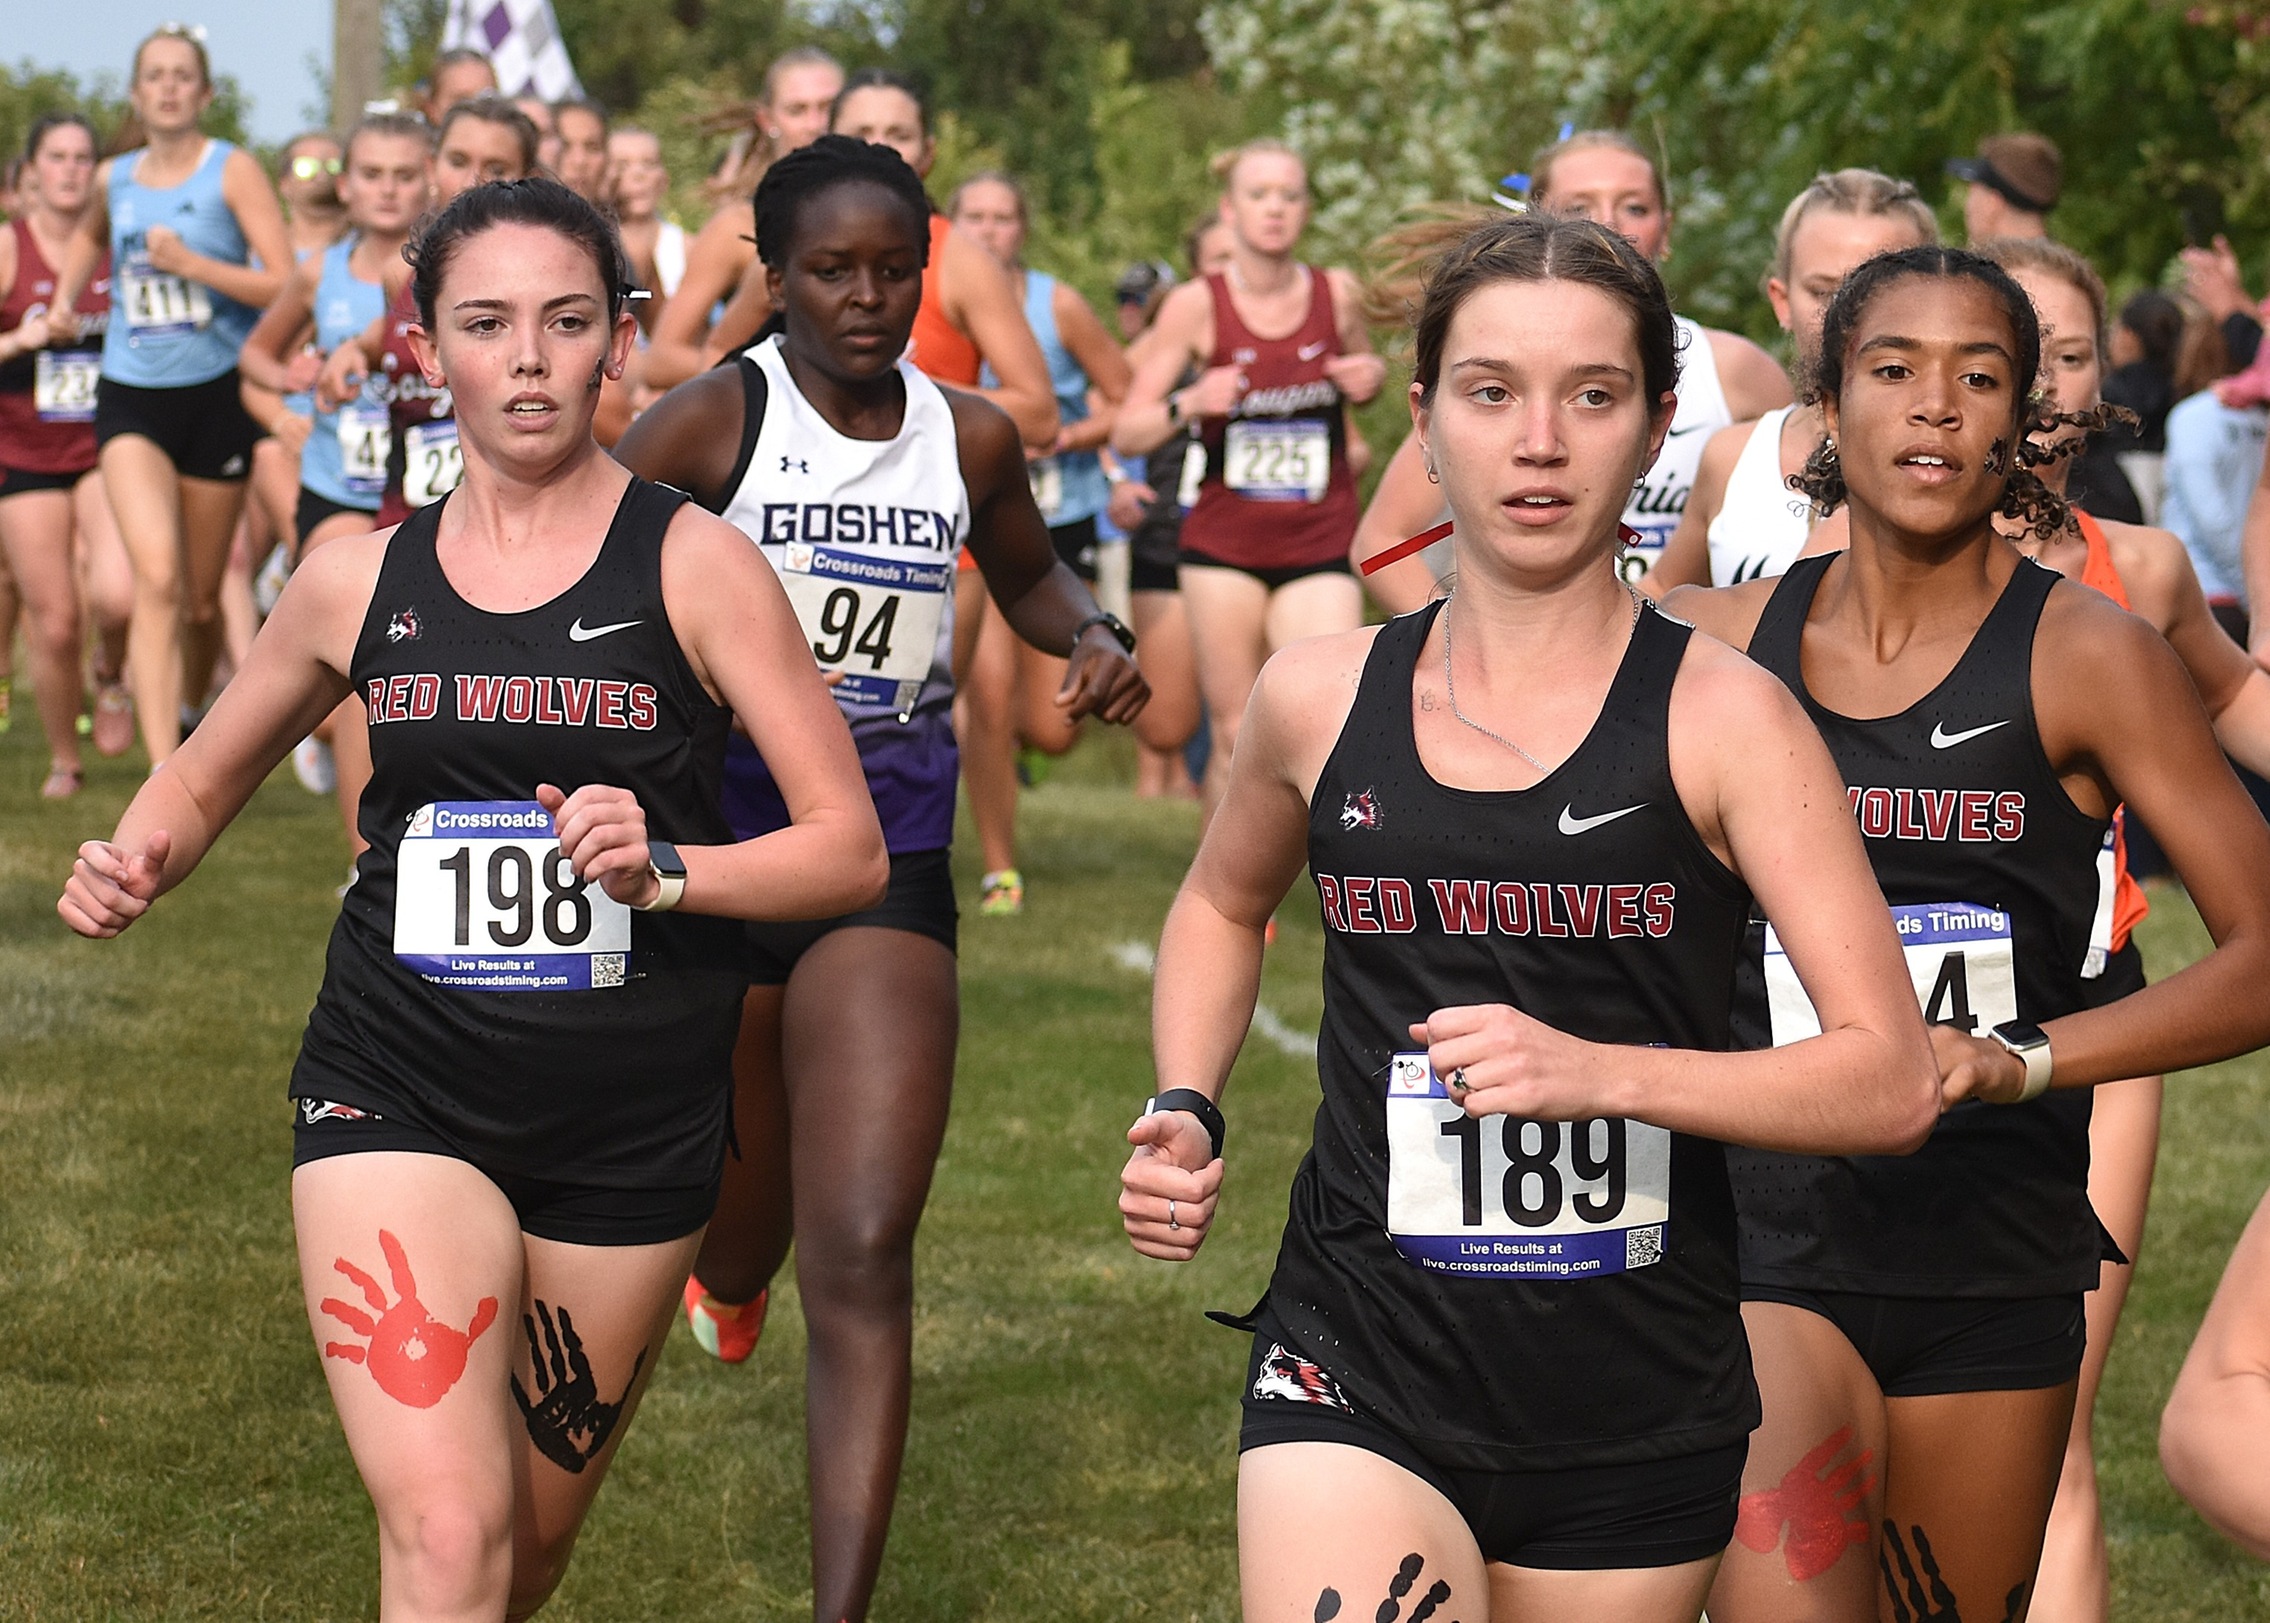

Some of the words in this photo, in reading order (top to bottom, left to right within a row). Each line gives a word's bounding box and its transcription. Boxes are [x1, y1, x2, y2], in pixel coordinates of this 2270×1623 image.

[135, 279, 191, 316] 411
[1230, 374, 1338, 418] ougars
[1244, 441, 1311, 482] 225
[760, 503, 959, 551] GOSHEN
[813, 552, 901, 582] Crossroads
[906, 568, 946, 589] Timing
[813, 587, 901, 670] 94
[368, 674, 441, 725] RED
[454, 674, 657, 730] WOLVES
[436, 810, 548, 828] Crossroads
[439, 845, 592, 947] 198
[1318, 873, 1417, 934] RED
[1427, 879, 1676, 940] WOLVES
[1928, 910, 2006, 933] Timing
[421, 973, 568, 988] live.crossroadstiming.com
[451, 959, 476, 971] Live
[478, 959, 521, 971] Results
[523, 960, 536, 971] at
[1441, 1113, 1627, 1227] 189
[1422, 1257, 1601, 1275] live.crossroadstiming.com
[1460, 1243, 1490, 1255] Live
[1493, 1243, 1546, 1255] Results
[1548, 1243, 1563, 1255] at
